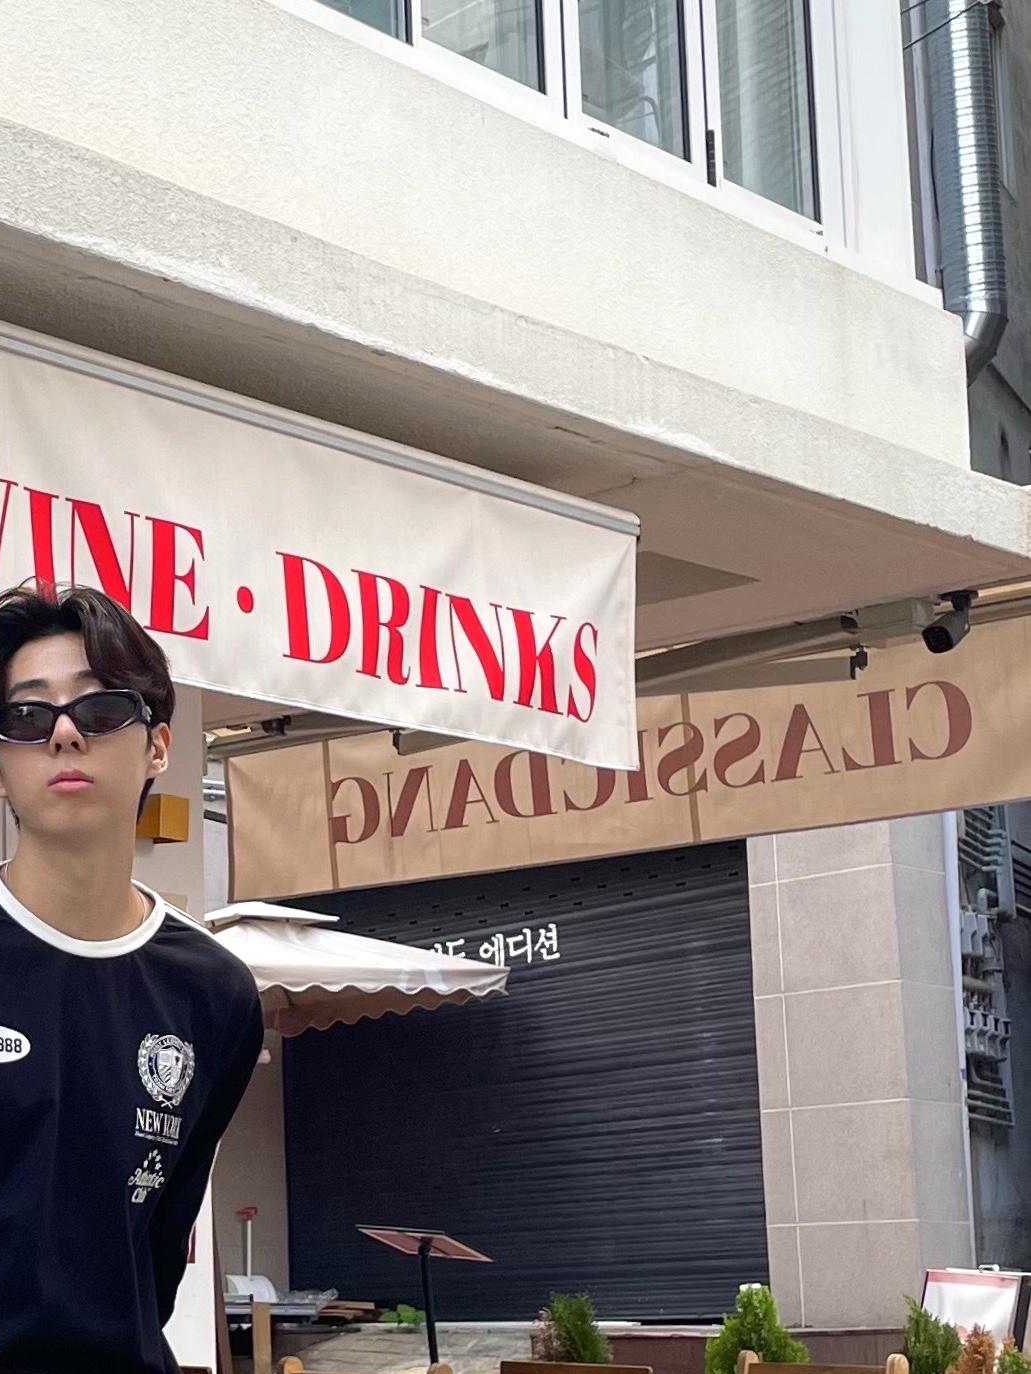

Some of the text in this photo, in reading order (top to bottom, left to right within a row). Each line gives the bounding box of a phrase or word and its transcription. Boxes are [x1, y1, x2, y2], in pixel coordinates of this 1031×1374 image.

[274, 551, 599, 723] DRINKS
[479, 923, 560, 967] 에디션
[135, 1107, 164, 1134] NEW
